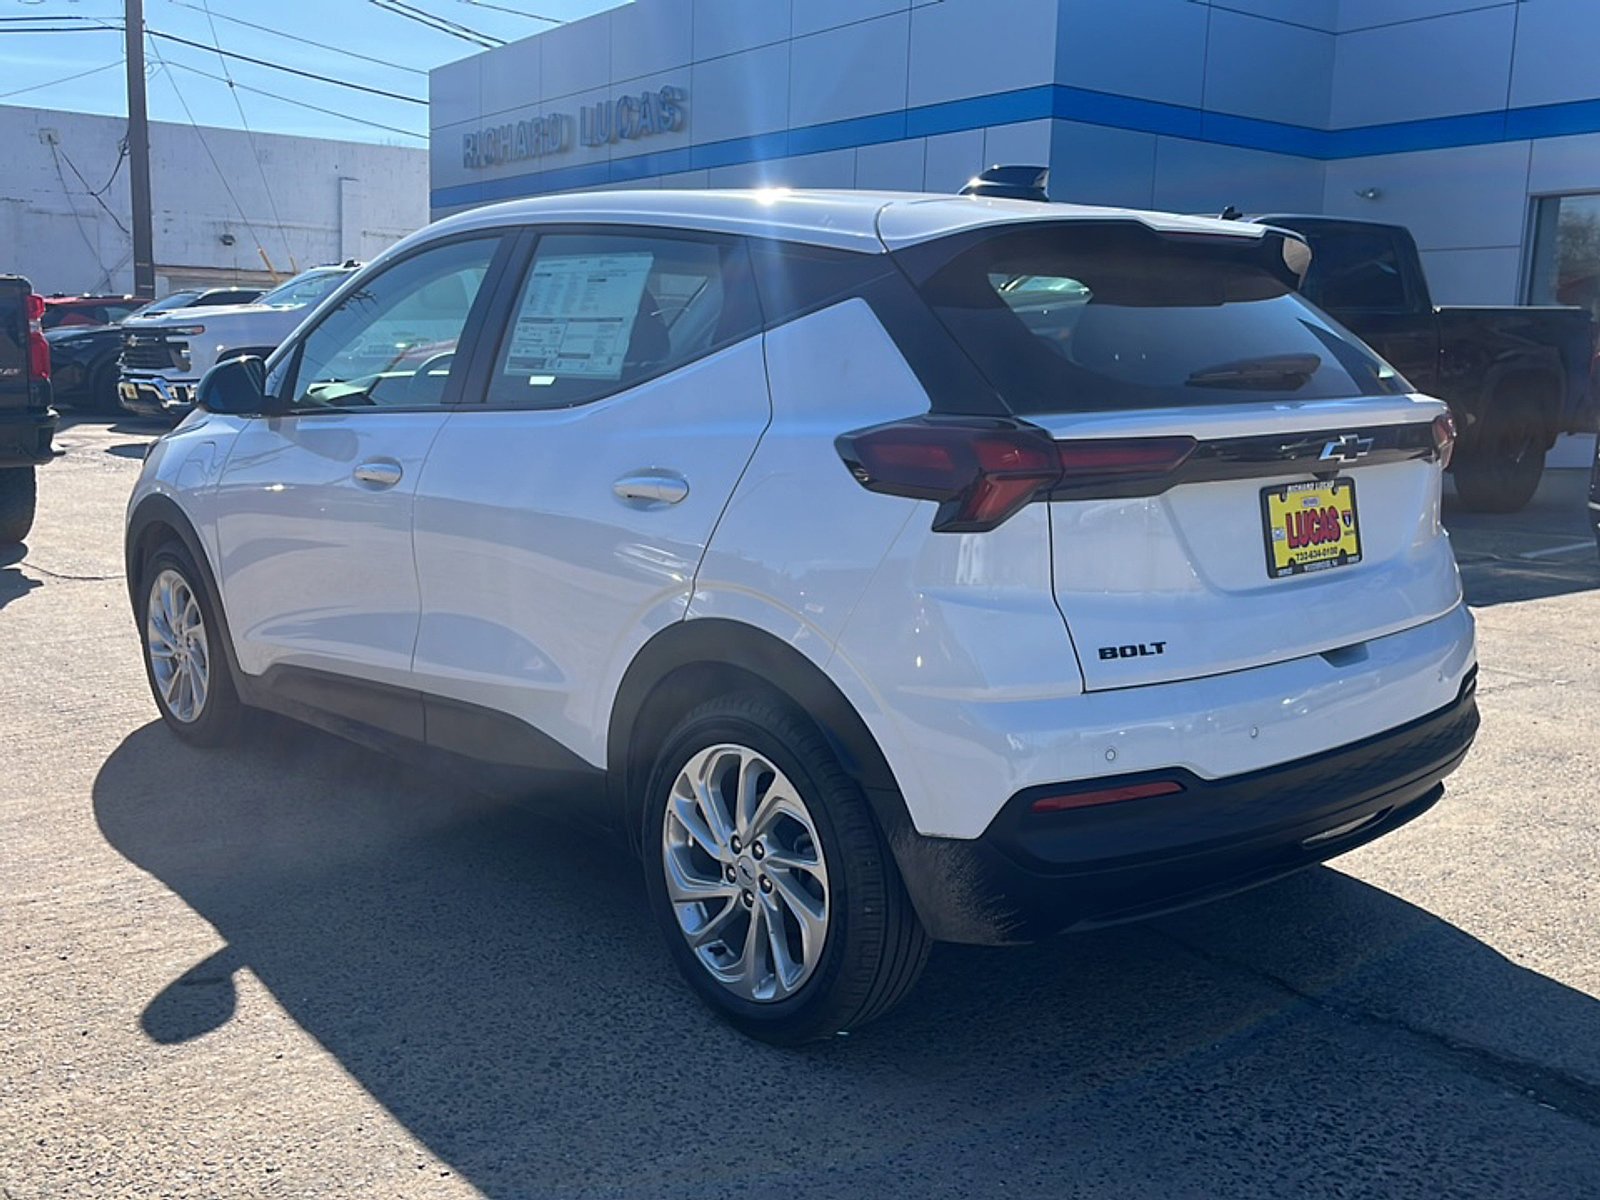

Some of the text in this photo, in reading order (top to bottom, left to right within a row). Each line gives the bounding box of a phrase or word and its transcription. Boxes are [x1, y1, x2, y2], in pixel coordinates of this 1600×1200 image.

[463, 85, 687, 169] RICHARD LUCAS
[1285, 505, 1341, 549] LUCAS
[1098, 641, 1167, 660] BOLT
